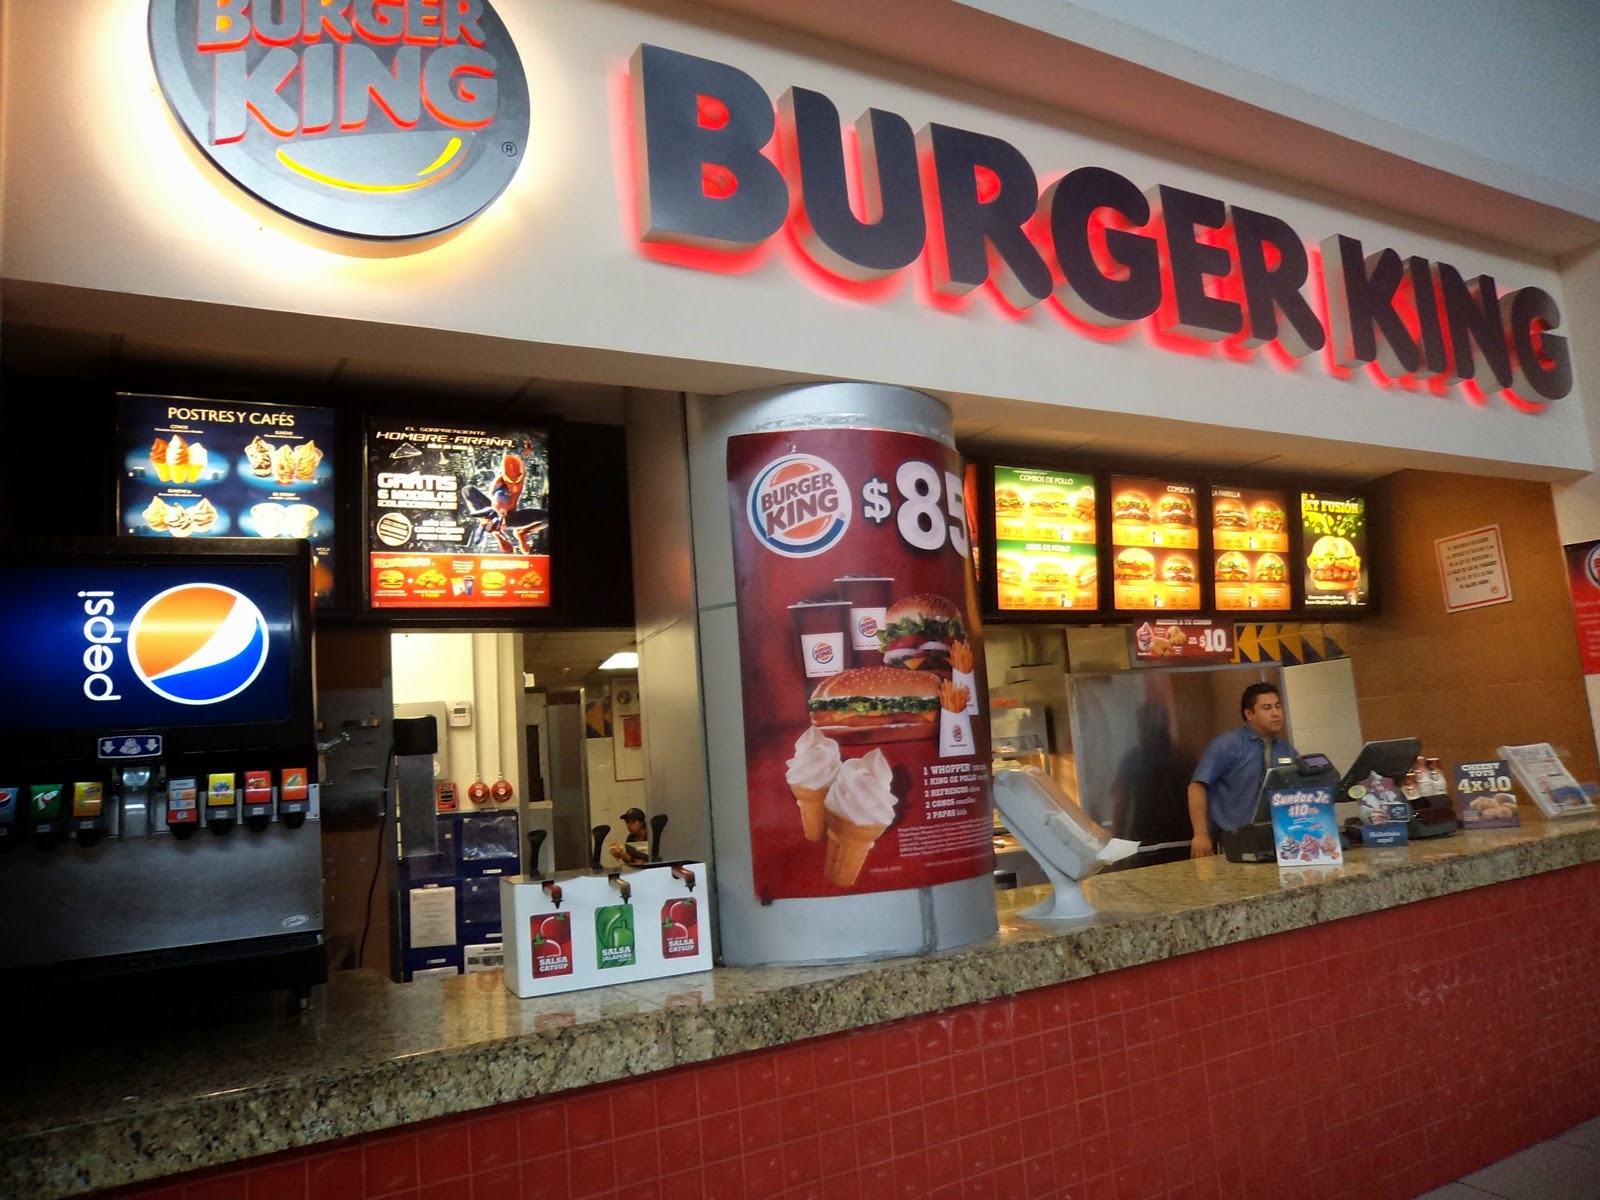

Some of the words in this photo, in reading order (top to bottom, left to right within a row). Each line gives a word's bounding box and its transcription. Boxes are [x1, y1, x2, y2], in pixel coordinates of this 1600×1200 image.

[208, 42, 498, 146] KING
[630, 43, 1325, 358] BURGER
[1319, 232, 1573, 402] KING
[167, 407, 235, 423] POSTRES
[236, 411, 247, 424] Y
[249, 412, 295, 427] CAFÉS
[1019, 474, 1045, 483] COMBOS
[1045, 476, 1055, 484] DE
[1055, 477, 1074, 485] POLLO
[761, 472, 834, 513] BURGER
[1167, 485, 1190, 494] COMBOS
[765, 488, 839, 538] KING
[77, 591, 122, 701] pepsi
[1199, 629, 1226, 652] $10
[923, 767, 928, 776] 1
[930, 763, 971, 775] WHOPPER
[1460, 763, 1501, 772] CHEESY
[930, 777, 948, 785] KING
[960, 774, 976, 782] POLLO
[931, 786, 969, 797] REFRESCOS
[925, 801, 931, 809] 2
[932, 798, 955, 808] CONOS
[1271, 791, 1315, 807] Sundae
[926, 812, 932, 820] 2
[932, 809, 956, 819] PAPAS
[668, 938, 694, 947] SALSA
[602, 946, 631, 956] SALSA
[668, 945, 695, 953] CATSUP
[539, 955, 568, 966] SALSA
[539, 963, 568, 972] CATSUP
